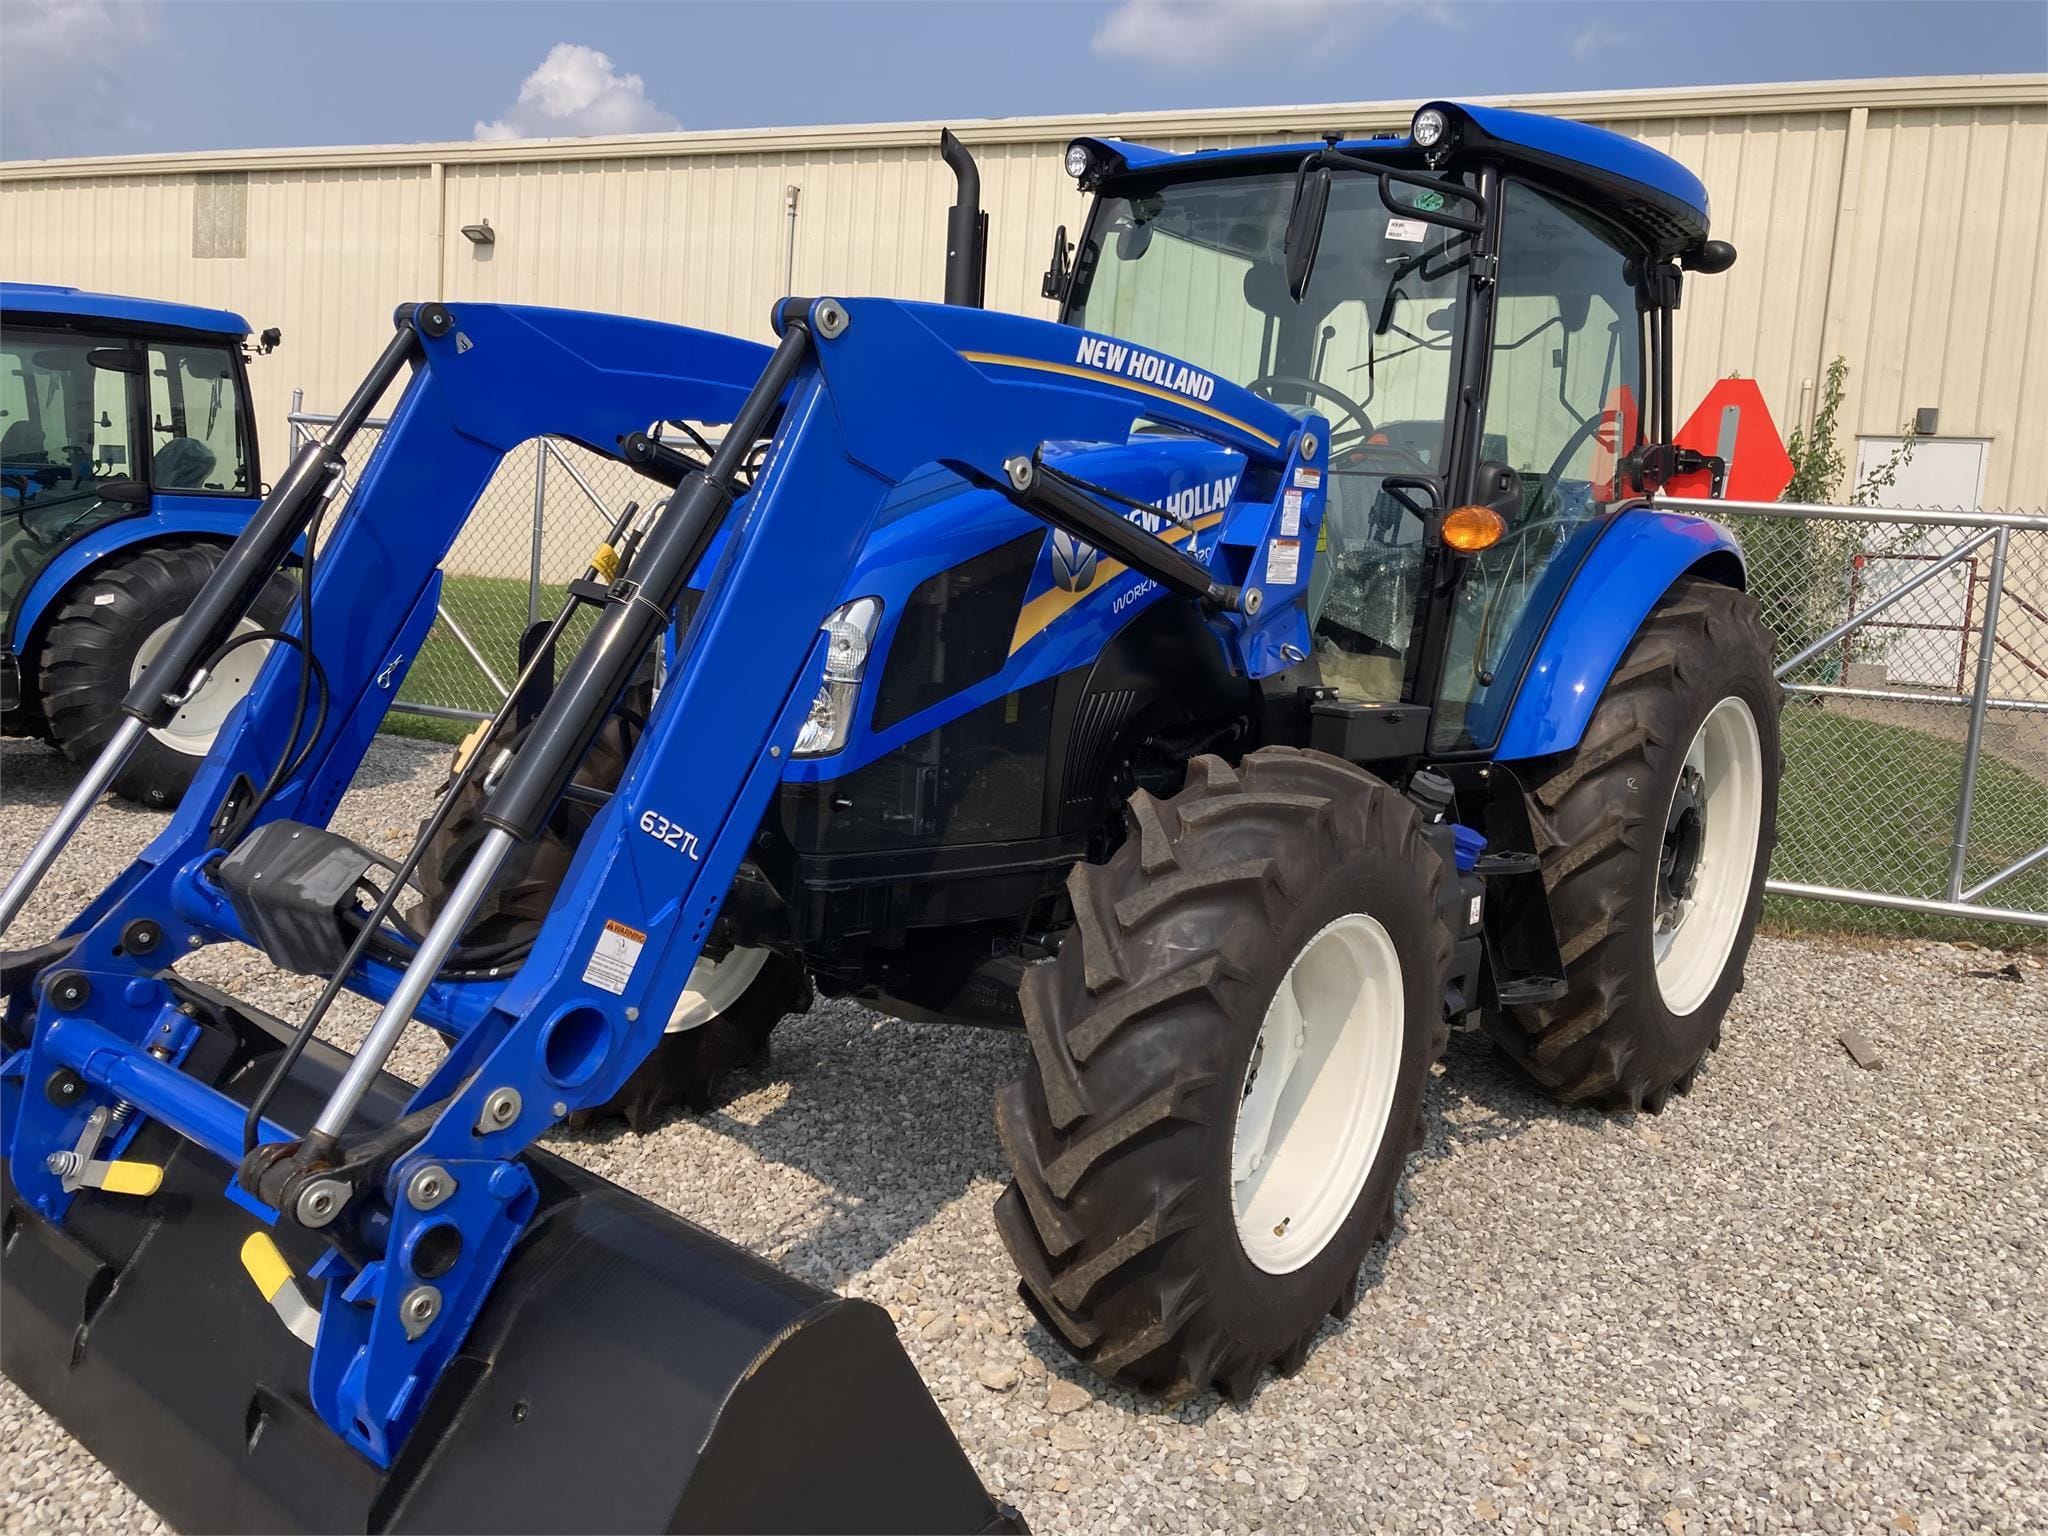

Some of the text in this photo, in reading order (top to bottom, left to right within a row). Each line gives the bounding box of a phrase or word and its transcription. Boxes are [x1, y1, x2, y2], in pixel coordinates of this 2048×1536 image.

[1076, 336, 1215, 402] NEW HOLLAND
[1121, 499, 1162, 533] EW
[1166, 475, 1237, 527] HOLLAN
[640, 810, 699, 861] 632TL
[614, 923, 645, 943] WARNING
